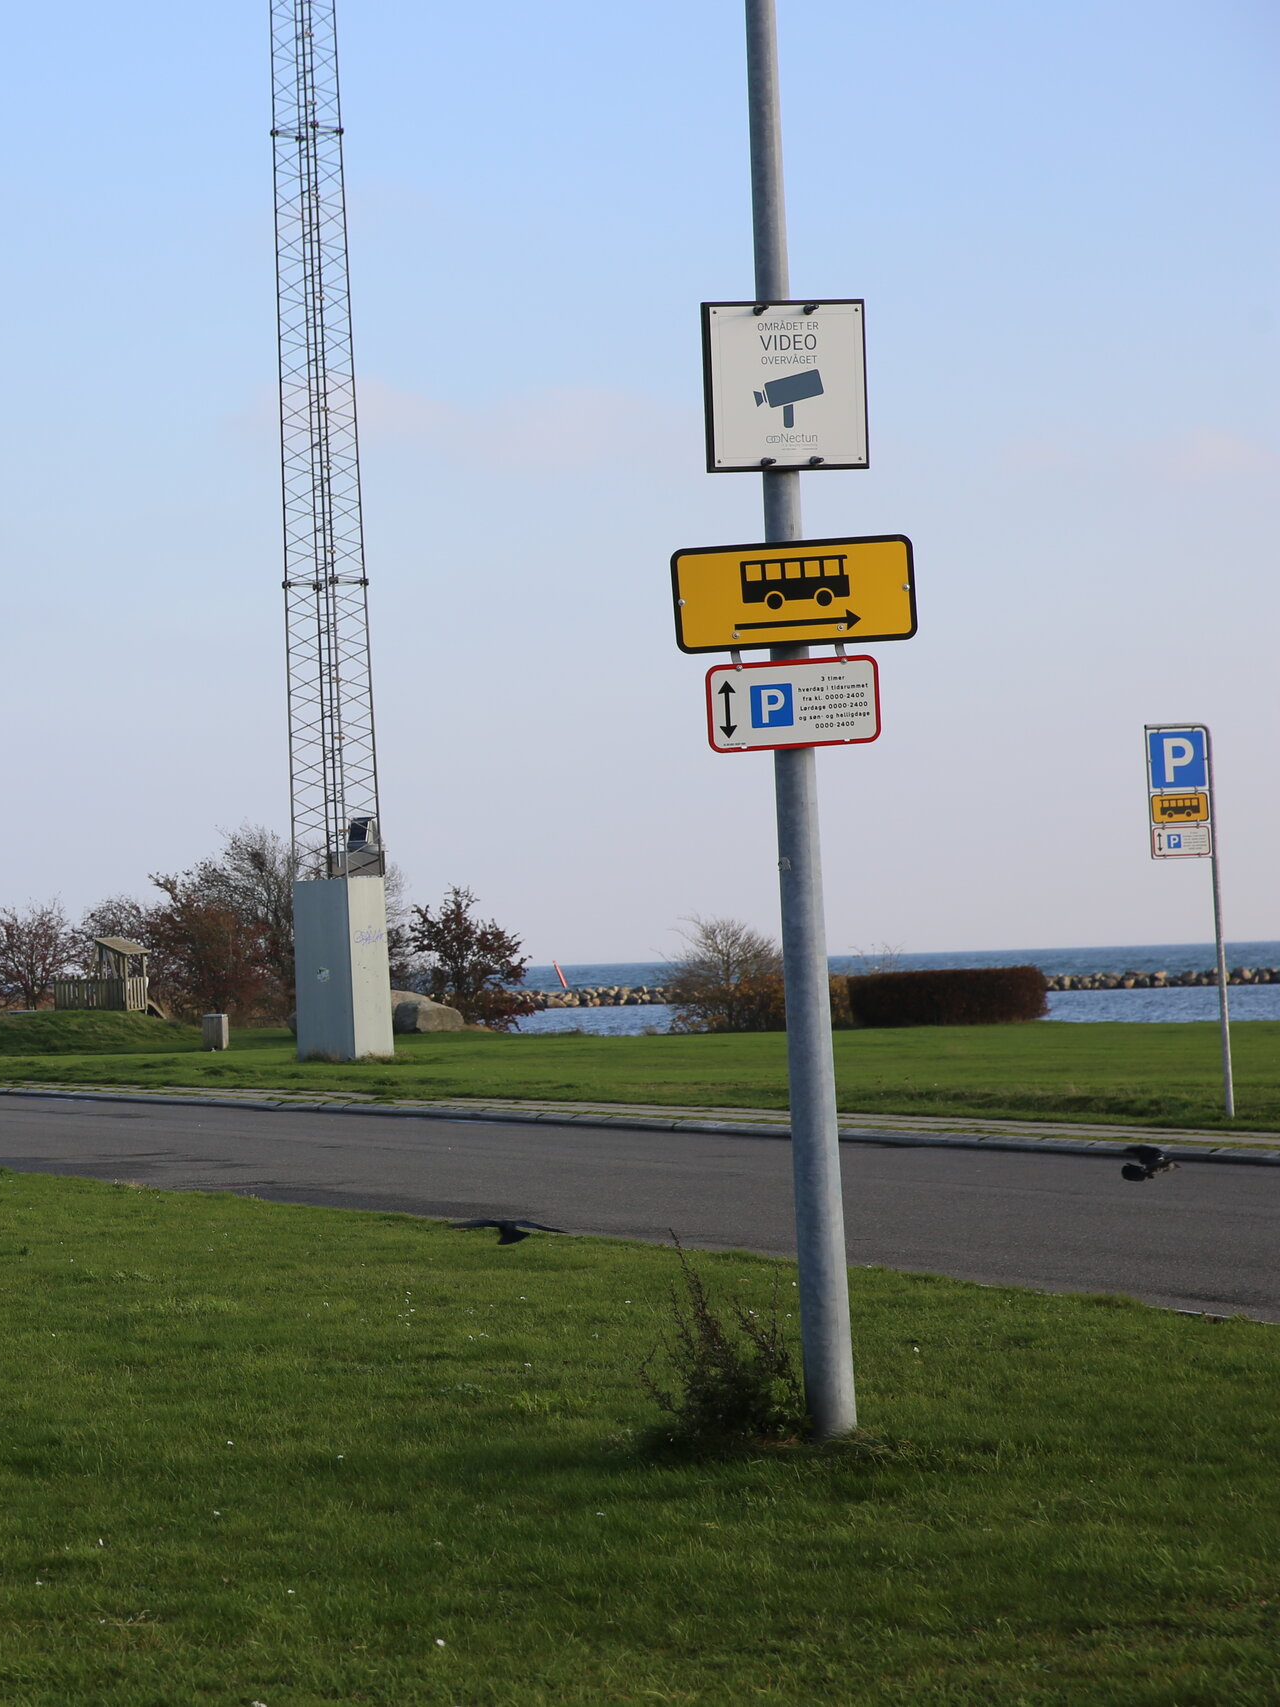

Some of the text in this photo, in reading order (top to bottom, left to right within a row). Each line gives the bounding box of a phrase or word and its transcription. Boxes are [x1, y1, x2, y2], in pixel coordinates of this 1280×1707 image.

[757, 320, 819, 331] OMRÅDET ER
[760, 333, 817, 351] VIDEO
[761, 353, 818, 365] OVERVÅGET
[831, 682, 869, 691] tidsrummet
[760, 688, 786, 724] P
[835, 711, 870, 719] helligdage
[1163, 737, 1195, 783] P
[1169, 835, 1180, 848] P
